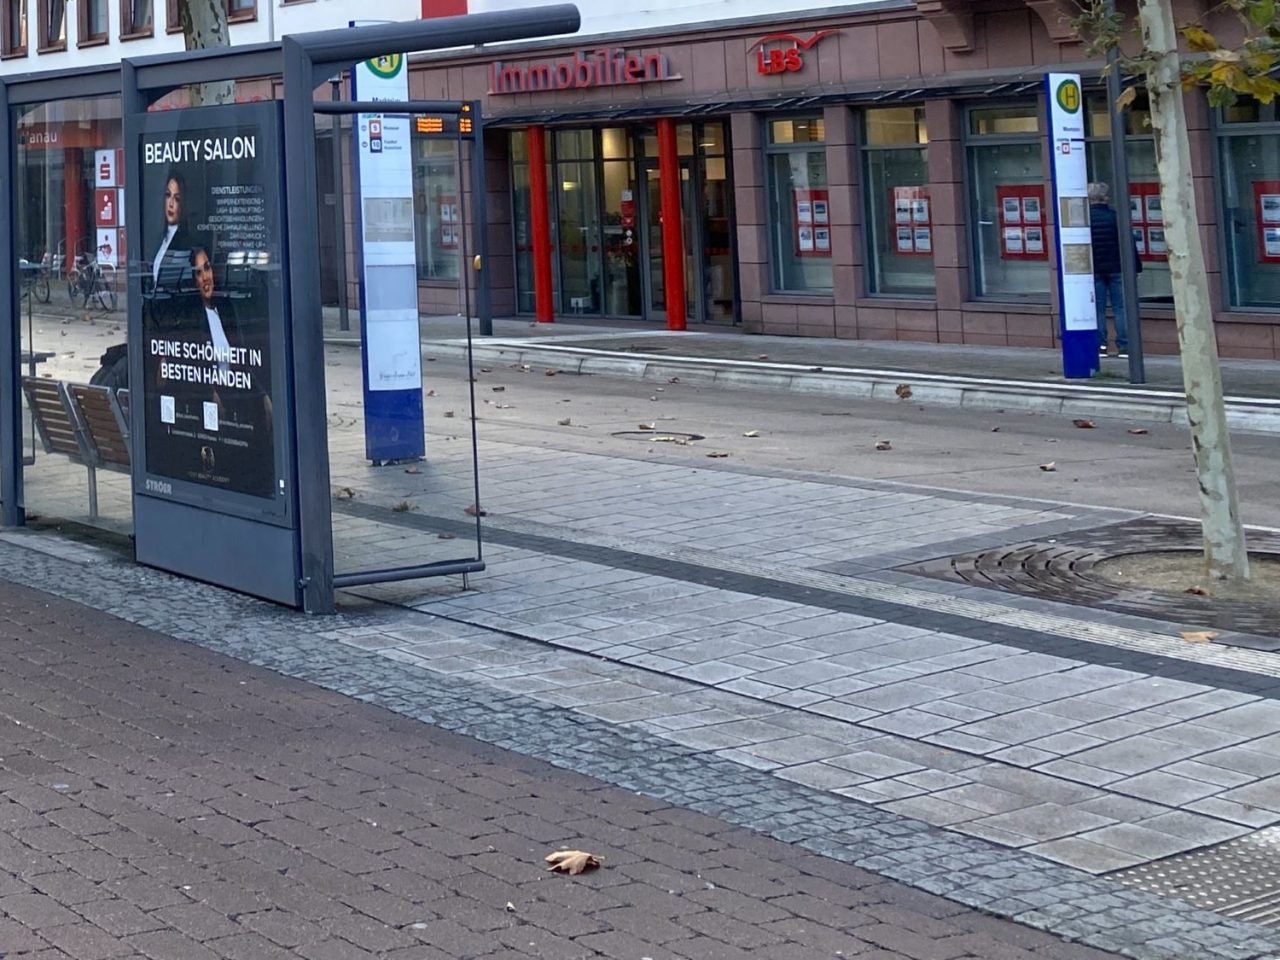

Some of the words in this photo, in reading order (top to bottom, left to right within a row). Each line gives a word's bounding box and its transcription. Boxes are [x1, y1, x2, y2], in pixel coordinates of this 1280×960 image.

[490, 48, 668, 93] Immobilien
[756, 47, 803, 76] LBS
[24, 131, 58, 144] anau
[144, 140, 201, 164] BEAUTY
[204, 136, 256, 161] SALON
[151, 339, 180, 356] DEINE
[183, 341, 247, 364] SCHÖNHEIT
[249, 349, 262, 367] IN
[161, 363, 202, 383] BESTEN
[204, 365, 251, 389] HÄNDEN
[146, 478, 172, 494] STRÖER
